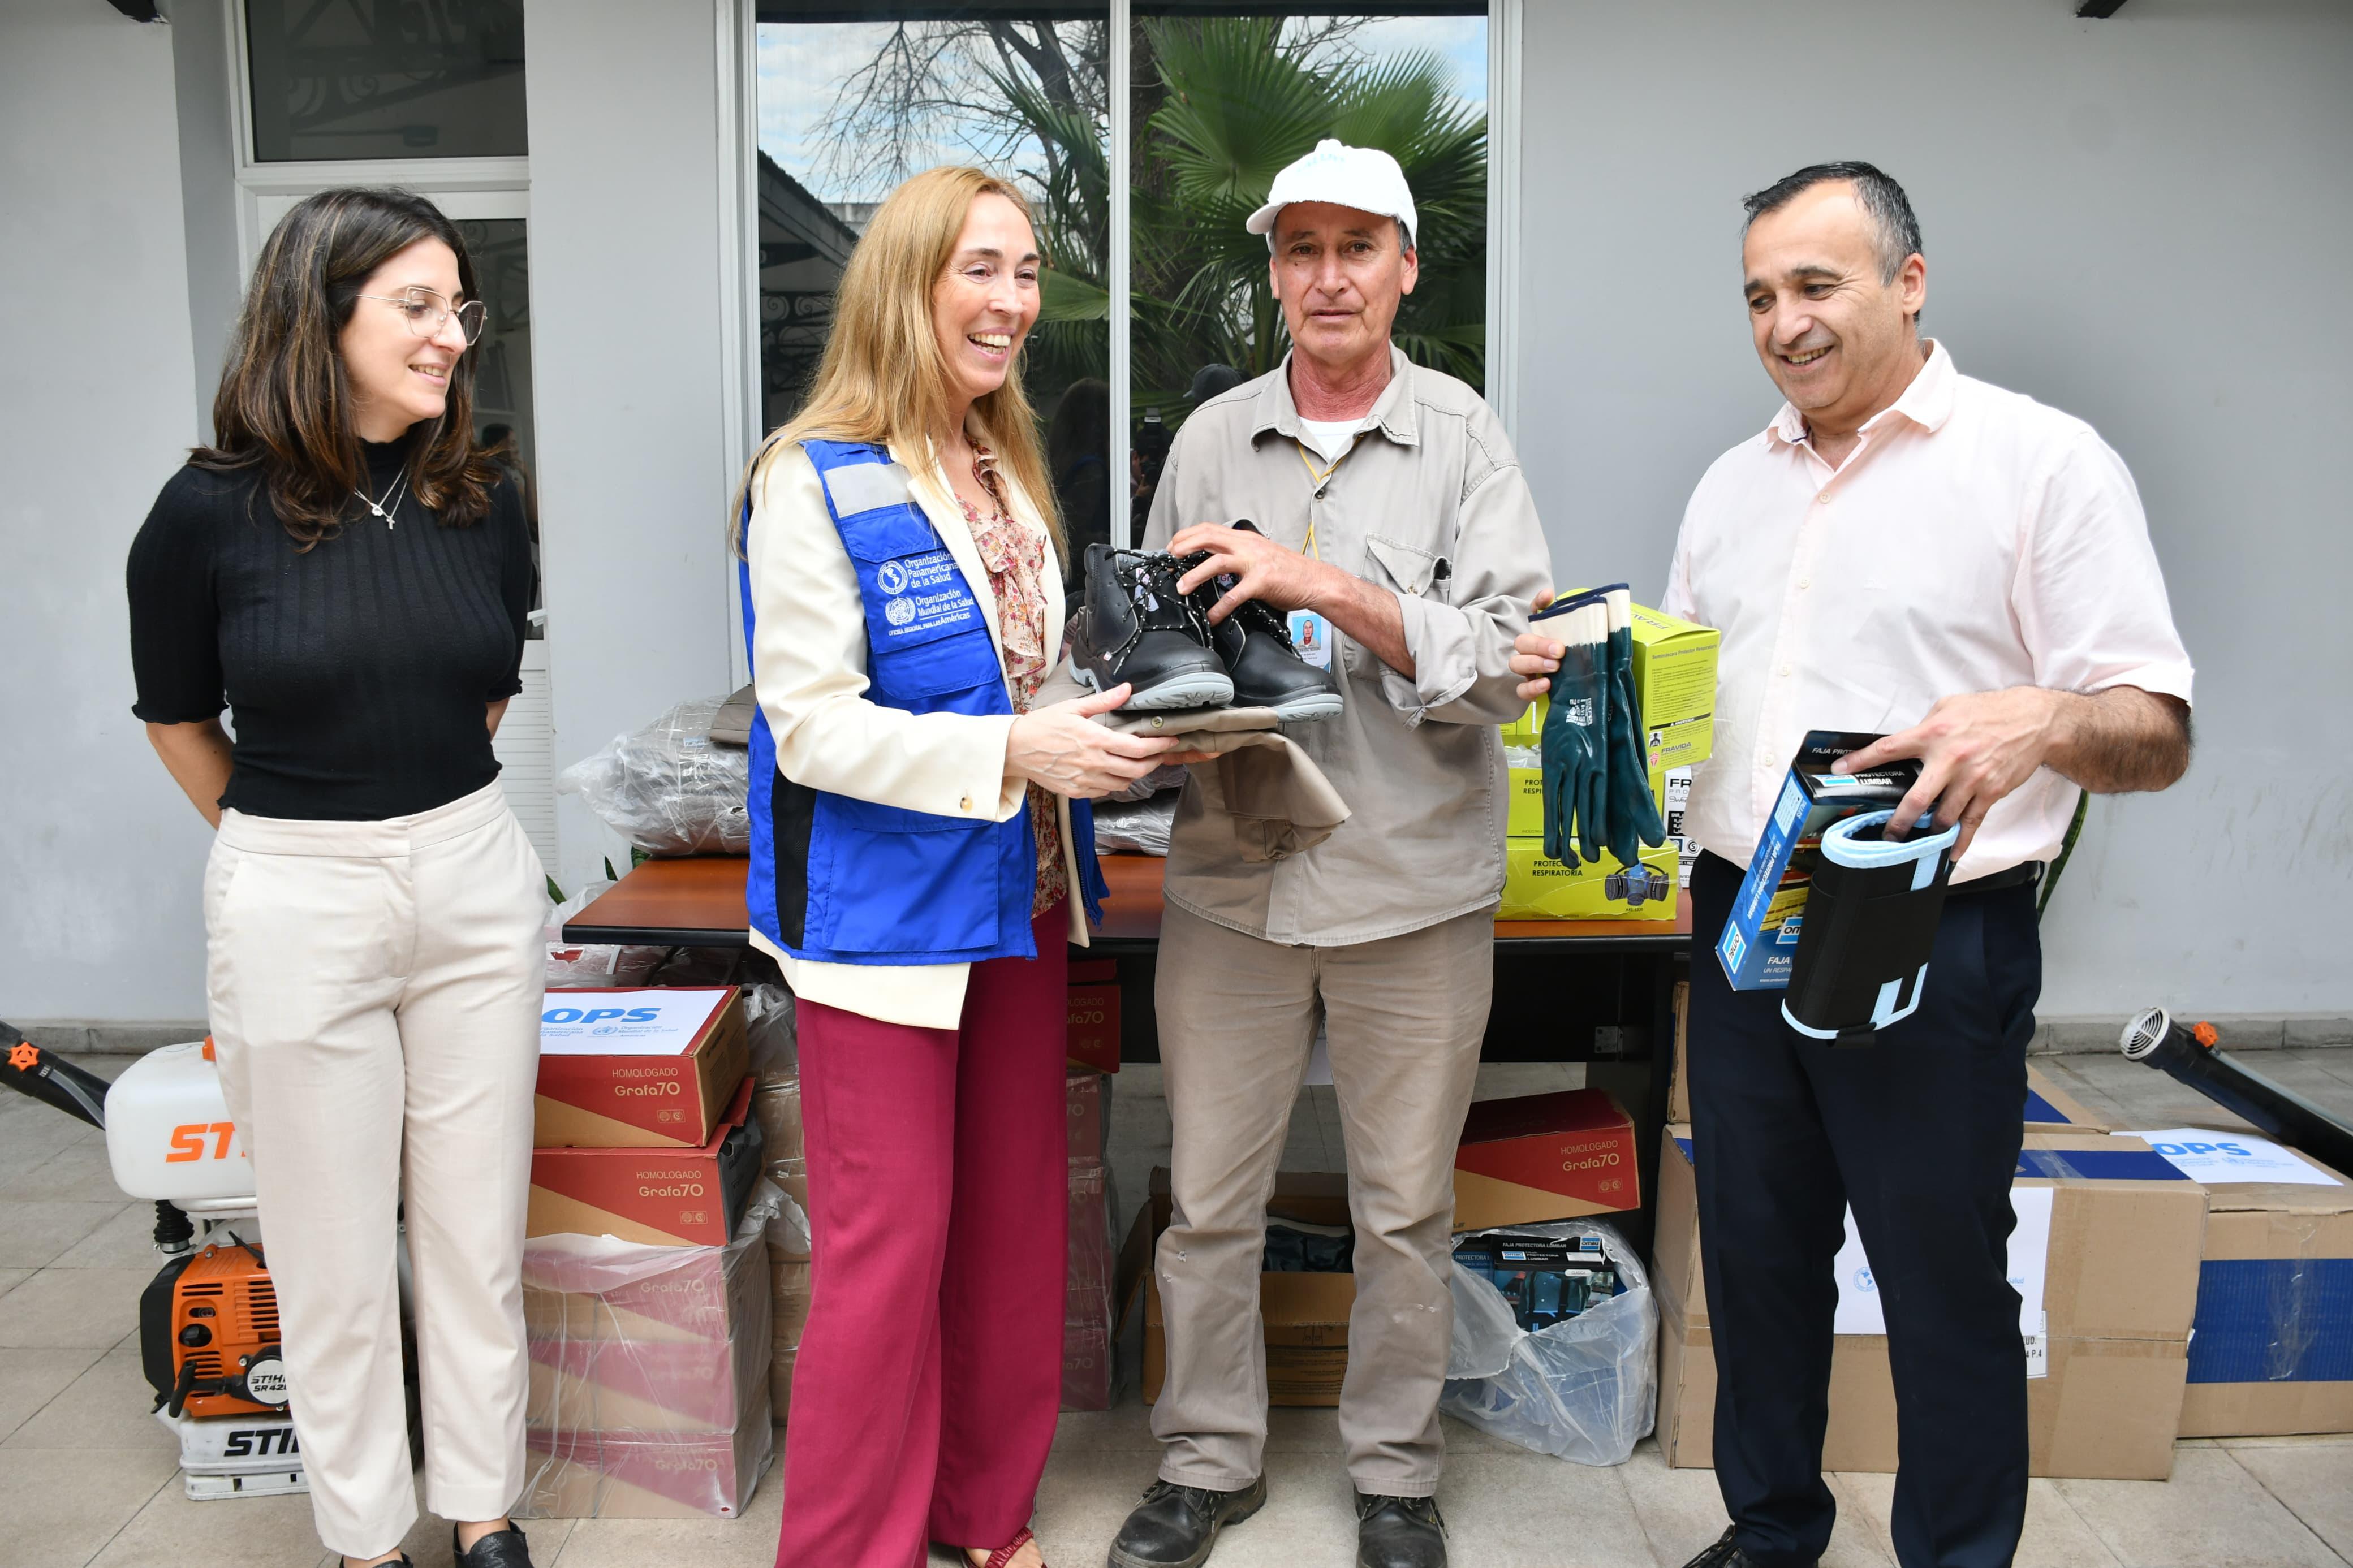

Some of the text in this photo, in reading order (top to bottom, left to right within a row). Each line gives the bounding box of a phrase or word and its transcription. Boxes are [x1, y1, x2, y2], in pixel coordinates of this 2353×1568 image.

[904, 552, 954, 569] Organización
[908, 562, 959, 579] Panamericana
[911, 572, 951, 588] de la Salud
[916, 589, 962, 607] Organización
[917, 597, 974, 616] Mundial de la Salud
[940, 612, 971, 624] Américas
[1661, 742, 1691, 754] FRAVIDA
[541, 1008, 661, 1023] OPS
[613, 1068, 678, 1078] HOMOLOGADO
[615, 1082, 680, 1096] Grafa70
[166, 1122, 246, 1163] ST
[1561, 1140, 1618, 1154] HOMOLOGADO
[2152, 1143, 2252, 1156] OPS
[1563, 1153, 1619, 1171] Grafa70
[636, 1170, 701, 1180] HOMOLOGADO
[639, 1183, 704, 1197] Grafa70
[2024, 1336, 2037, 1345] UD.
